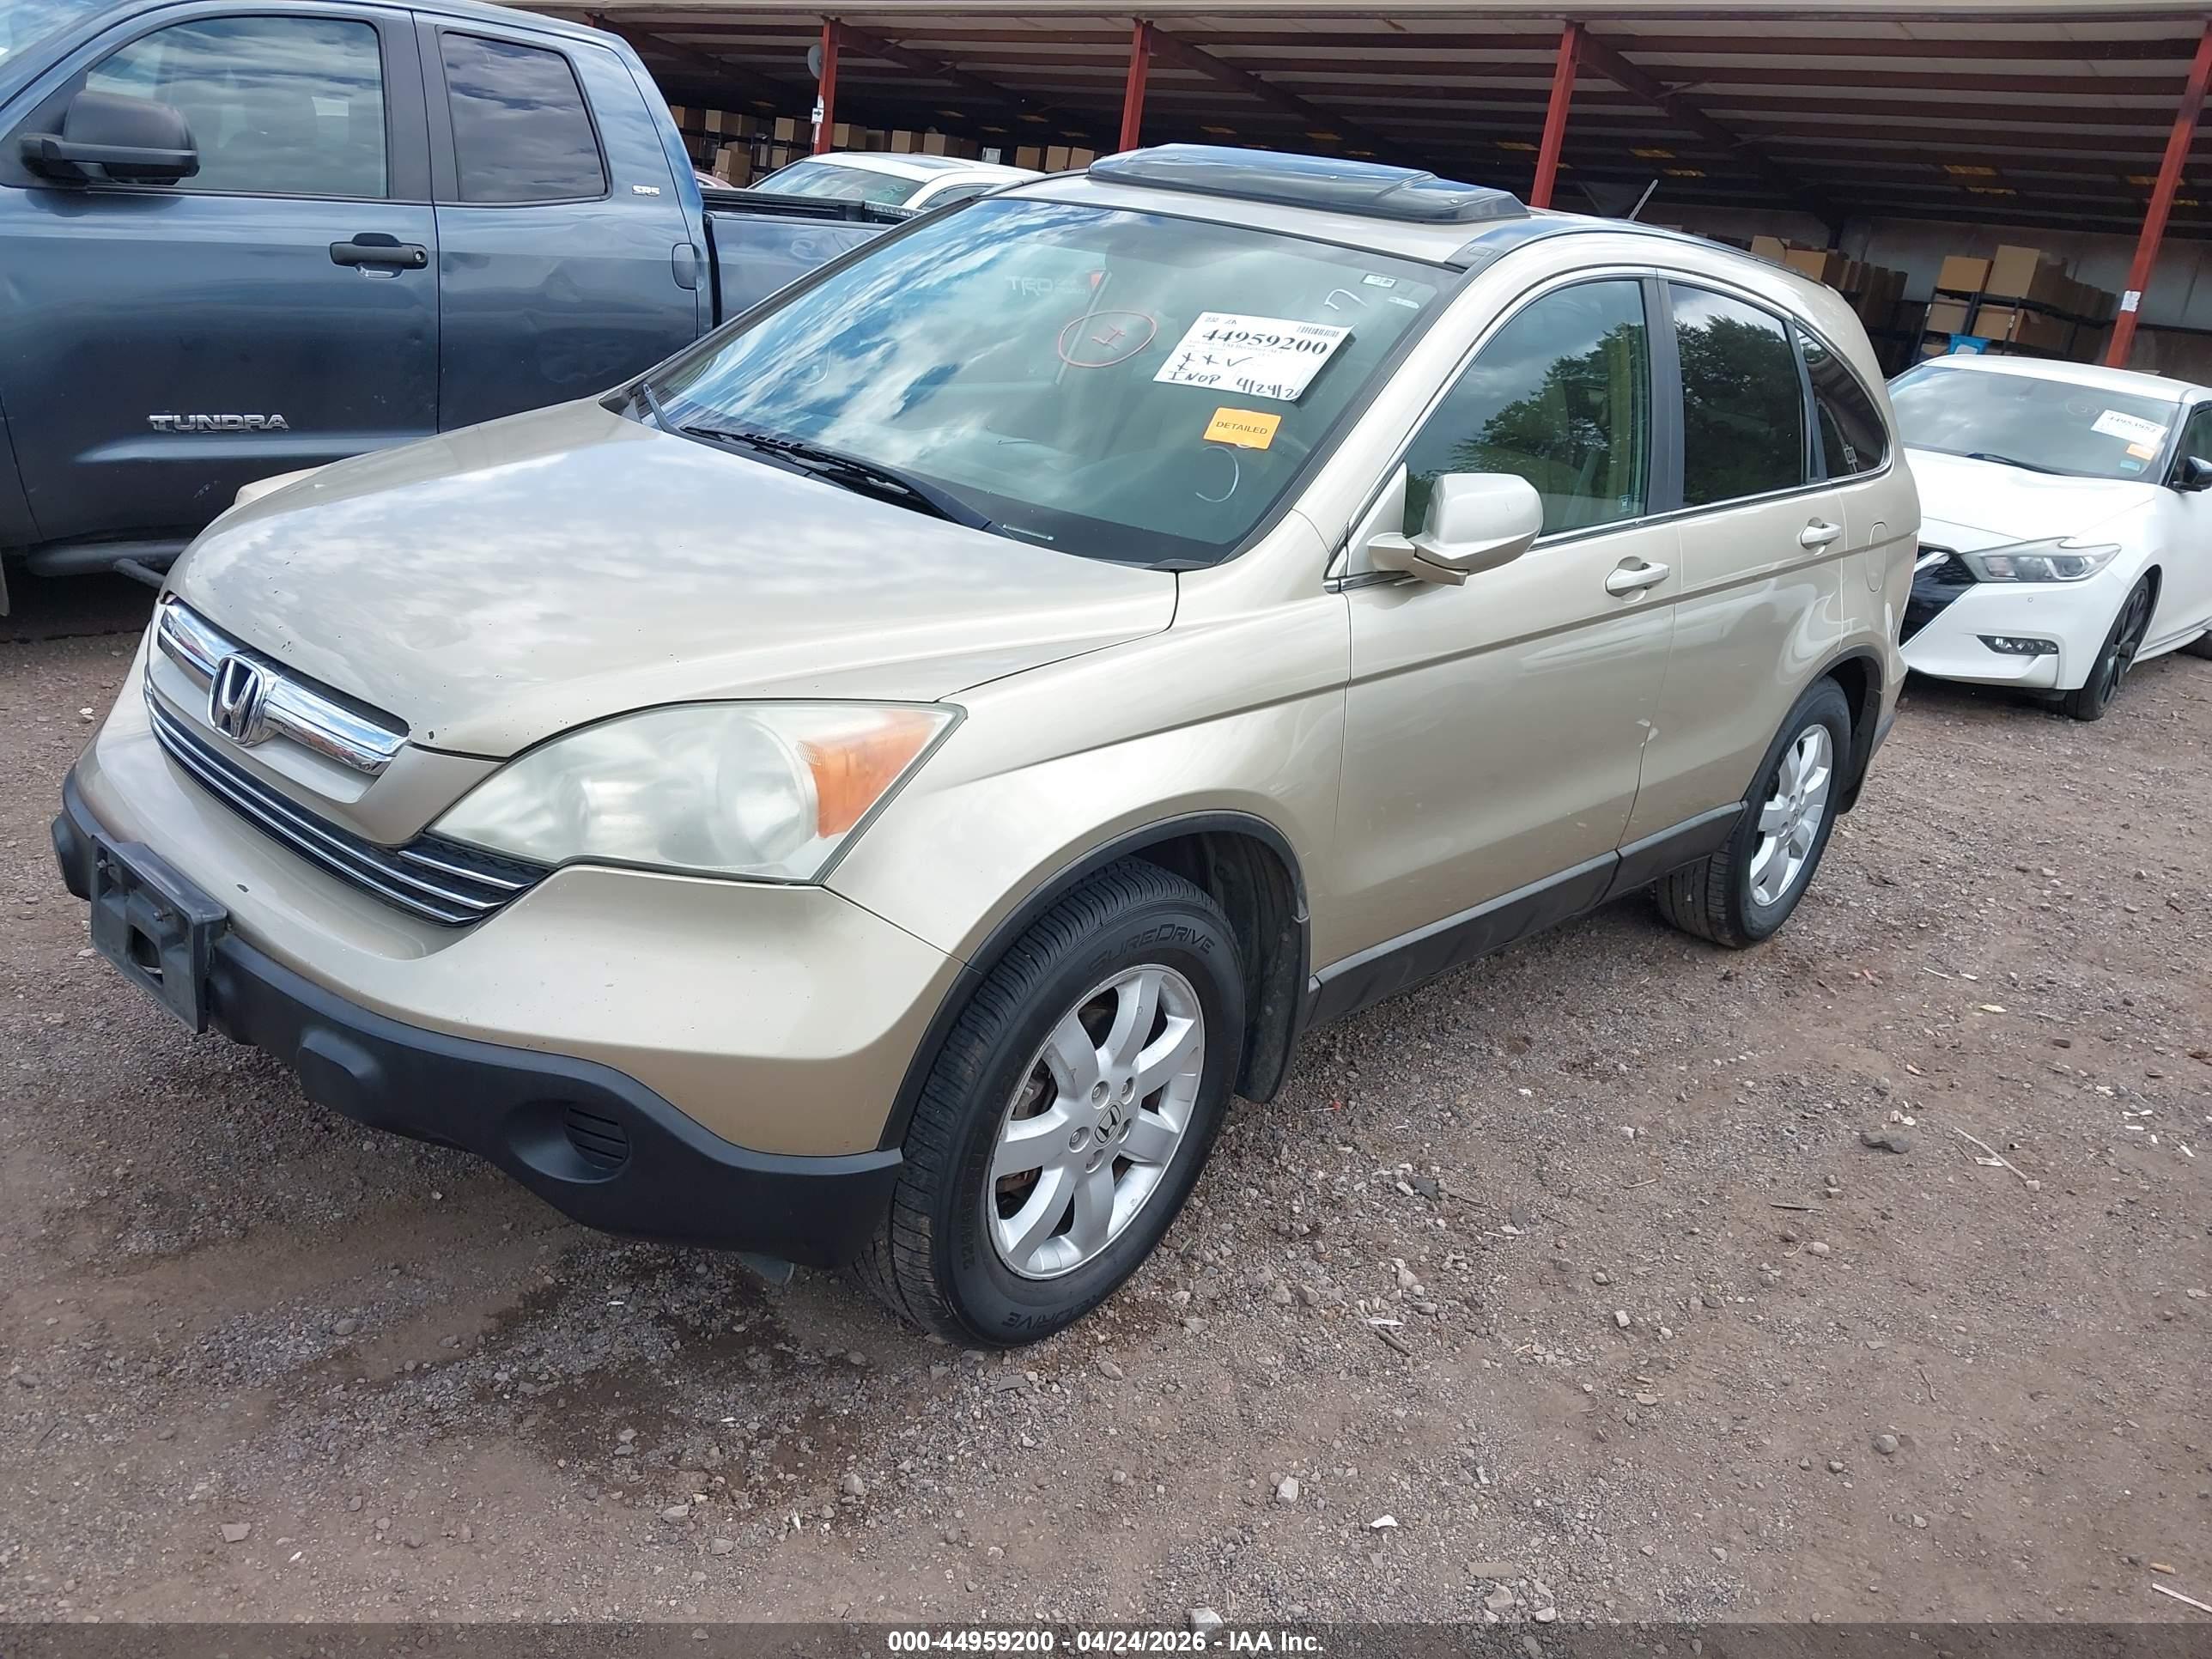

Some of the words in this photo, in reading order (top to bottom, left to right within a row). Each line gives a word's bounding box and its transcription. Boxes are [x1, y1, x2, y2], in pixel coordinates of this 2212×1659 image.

[632, 185, 660, 197] SR5
[1005, 276, 1054, 296] TRD
[1202, 329, 1328, 356] 44959200
[1168, 370, 1221, 386] INOP
[148, 414, 290, 432] TUNDRA
[1215, 421, 1268, 435] DETAILED
